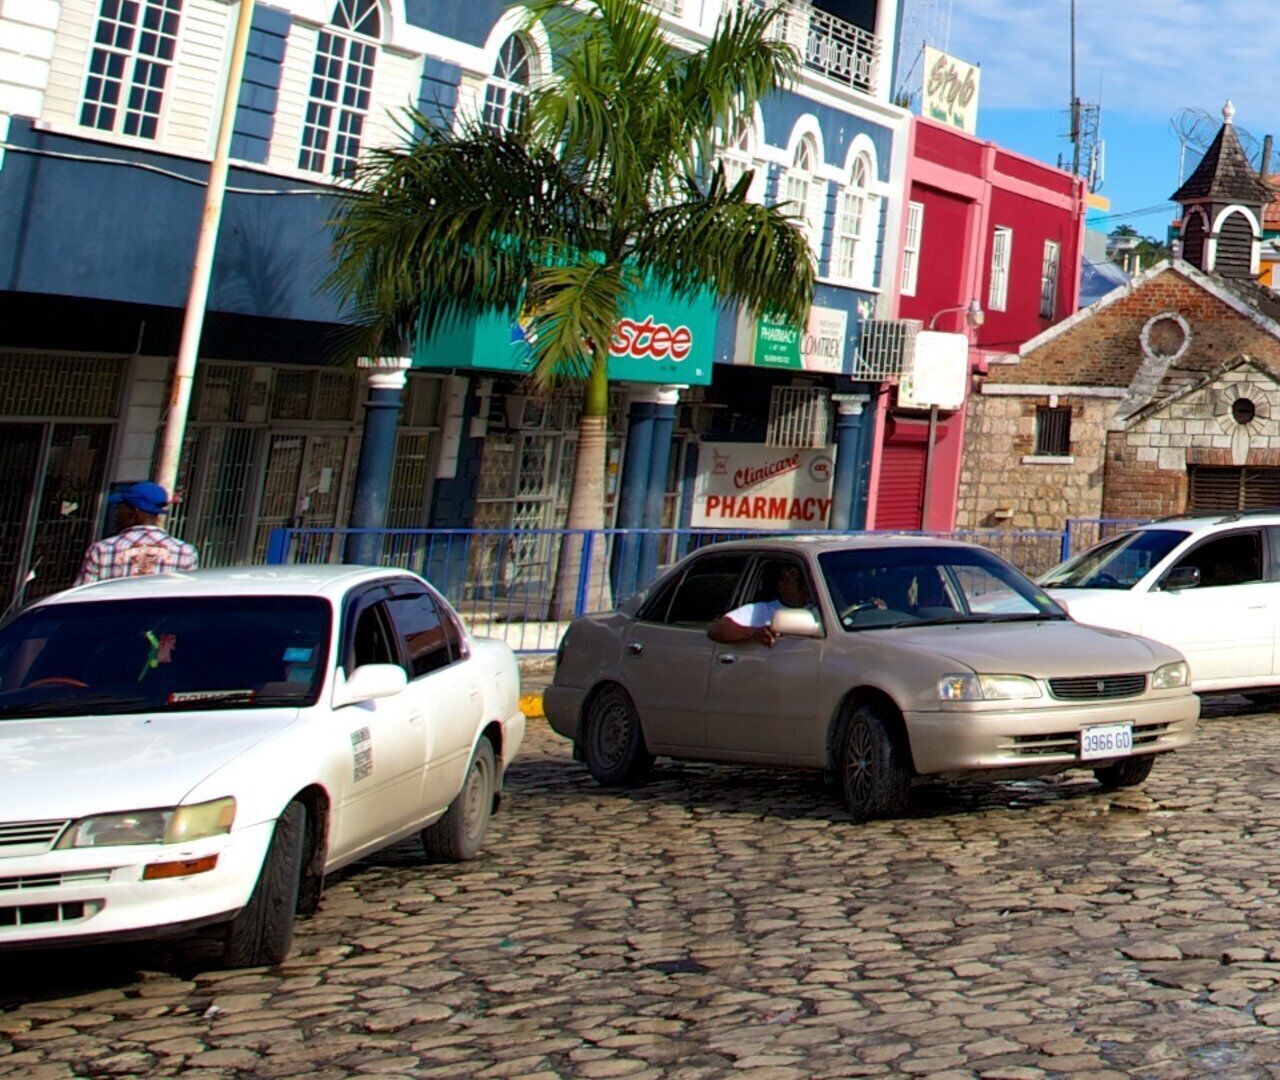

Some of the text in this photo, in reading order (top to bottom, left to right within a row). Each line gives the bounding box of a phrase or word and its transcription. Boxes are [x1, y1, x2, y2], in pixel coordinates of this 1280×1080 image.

[760, 326, 798, 344] PHARMACY
[733, 453, 802, 489] Clinicare
[705, 495, 832, 522] PHARMACY
[1084, 733, 1114, 753] 3966
